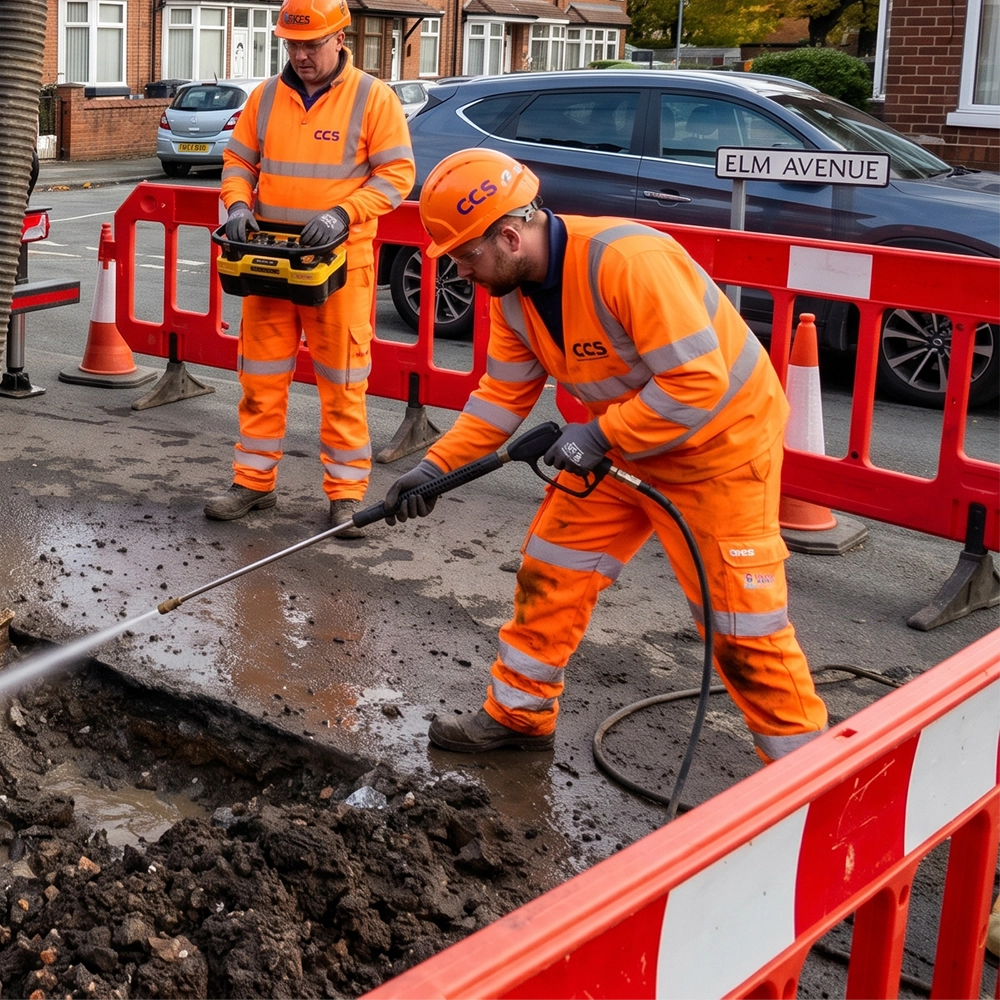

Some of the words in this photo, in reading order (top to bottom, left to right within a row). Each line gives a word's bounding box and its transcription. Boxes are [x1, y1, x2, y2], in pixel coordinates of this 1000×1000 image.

[314, 130, 340, 141] CCS
[725, 154, 771, 174] ELM
[782, 157, 879, 180] AVENUE
[456, 179, 498, 215] CCS
[572, 341, 608, 357] CCS
